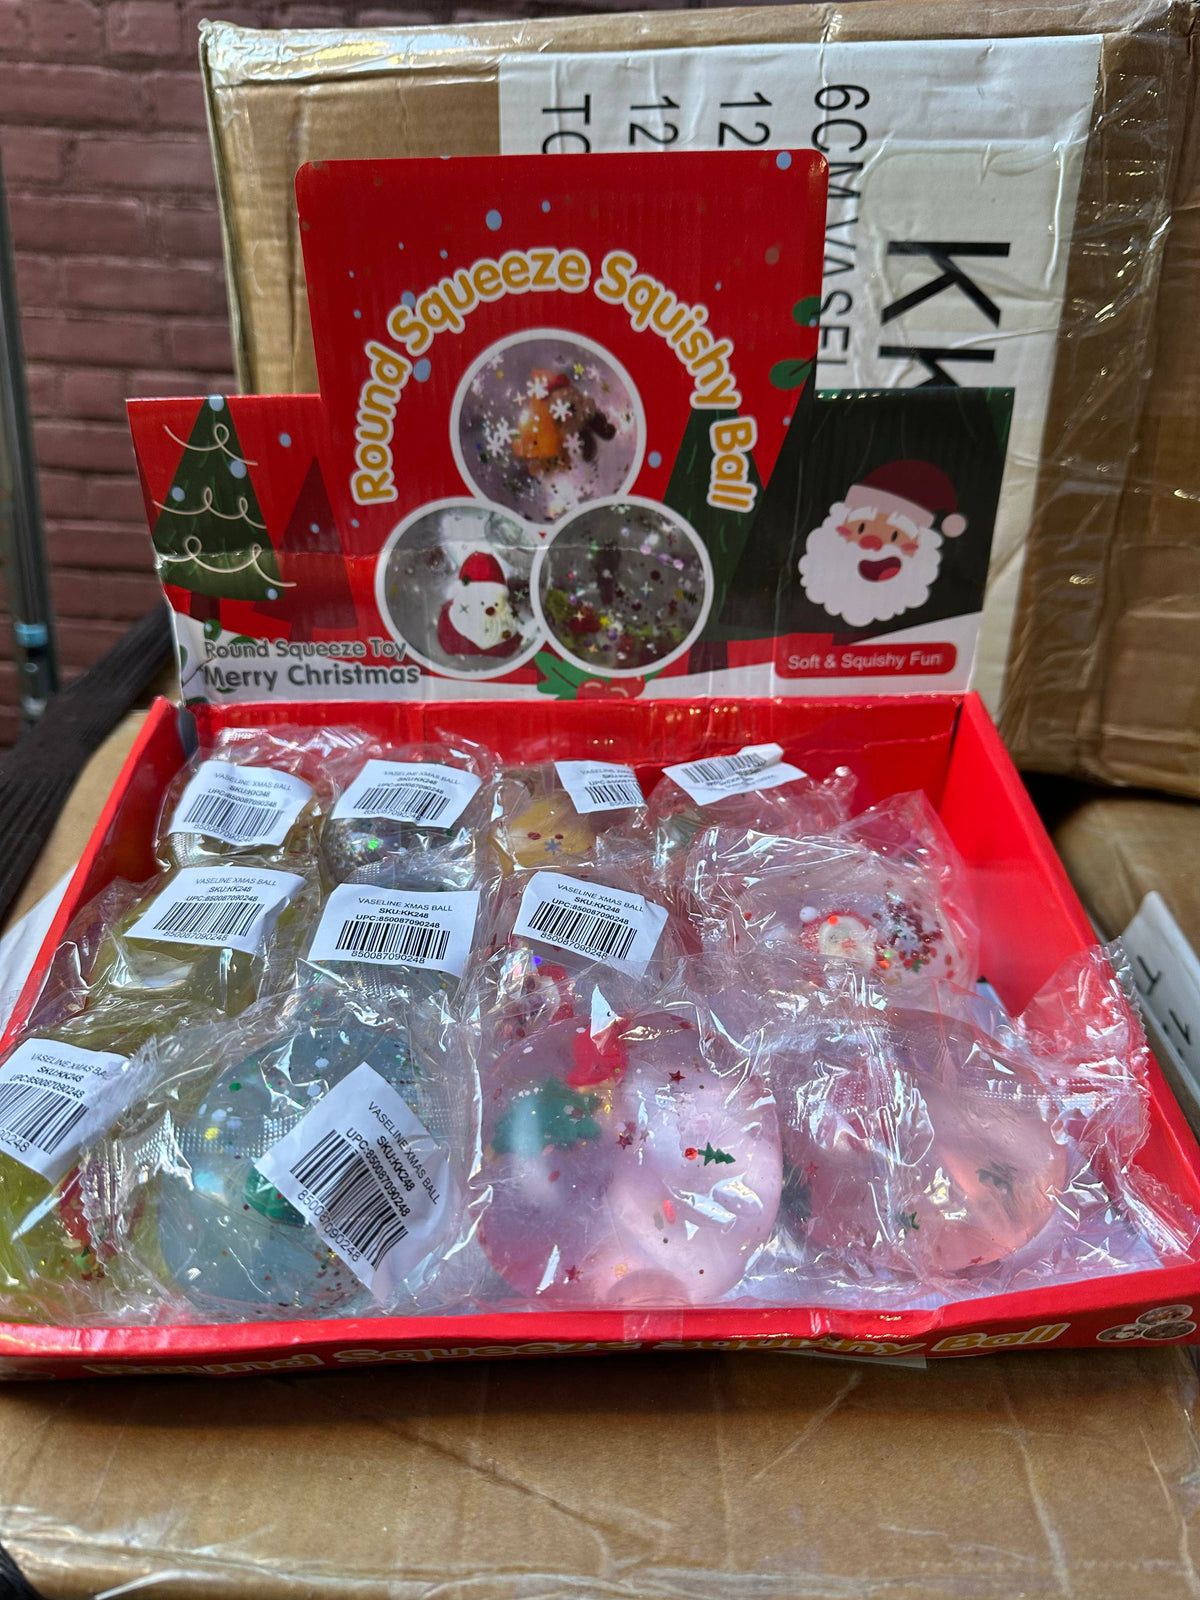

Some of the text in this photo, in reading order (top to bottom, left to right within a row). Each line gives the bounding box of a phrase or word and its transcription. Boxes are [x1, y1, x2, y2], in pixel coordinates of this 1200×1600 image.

[629, 96, 680, 146] 12
[719, 92, 772, 148] 12
[354, 250, 755, 511] Round Squeeze Squishy Ball
[204, 639, 407, 662] Round Squeeze Toy
[787, 651, 942, 671] Soft & Squishy Fun
[204, 664, 420, 691] Merry Christmas
[195, 877, 232, 885] VASELINE
[232, 877, 256, 885] XMAS
[358, 897, 401, 907] VASELINE
[403, 902, 430, 911] XMAS
[551, 897, 629, 925] UPC:850087090248
[557, 883, 644, 913] VASELINE XMAS BALL
[574, 896, 621, 914] SKU:KK248
[355, 914, 440, 929] UPC:850087090248
[378, 907, 430, 919] SKU:KK248
[351, 950, 426, 964] 850087090248
[540, 932, 609, 960] 850087090248
[92, 1066, 108, 1078] BA
[368, 1101, 441, 1205] VASELINE XMAS BALL
[376, 1135, 416, 1192] SKU:KK248
[346, 1127, 411, 1217] UPC:850087090248
[298, 1190, 360, 1263] 850087090248
[932, 1322, 1072, 1352] Ball
